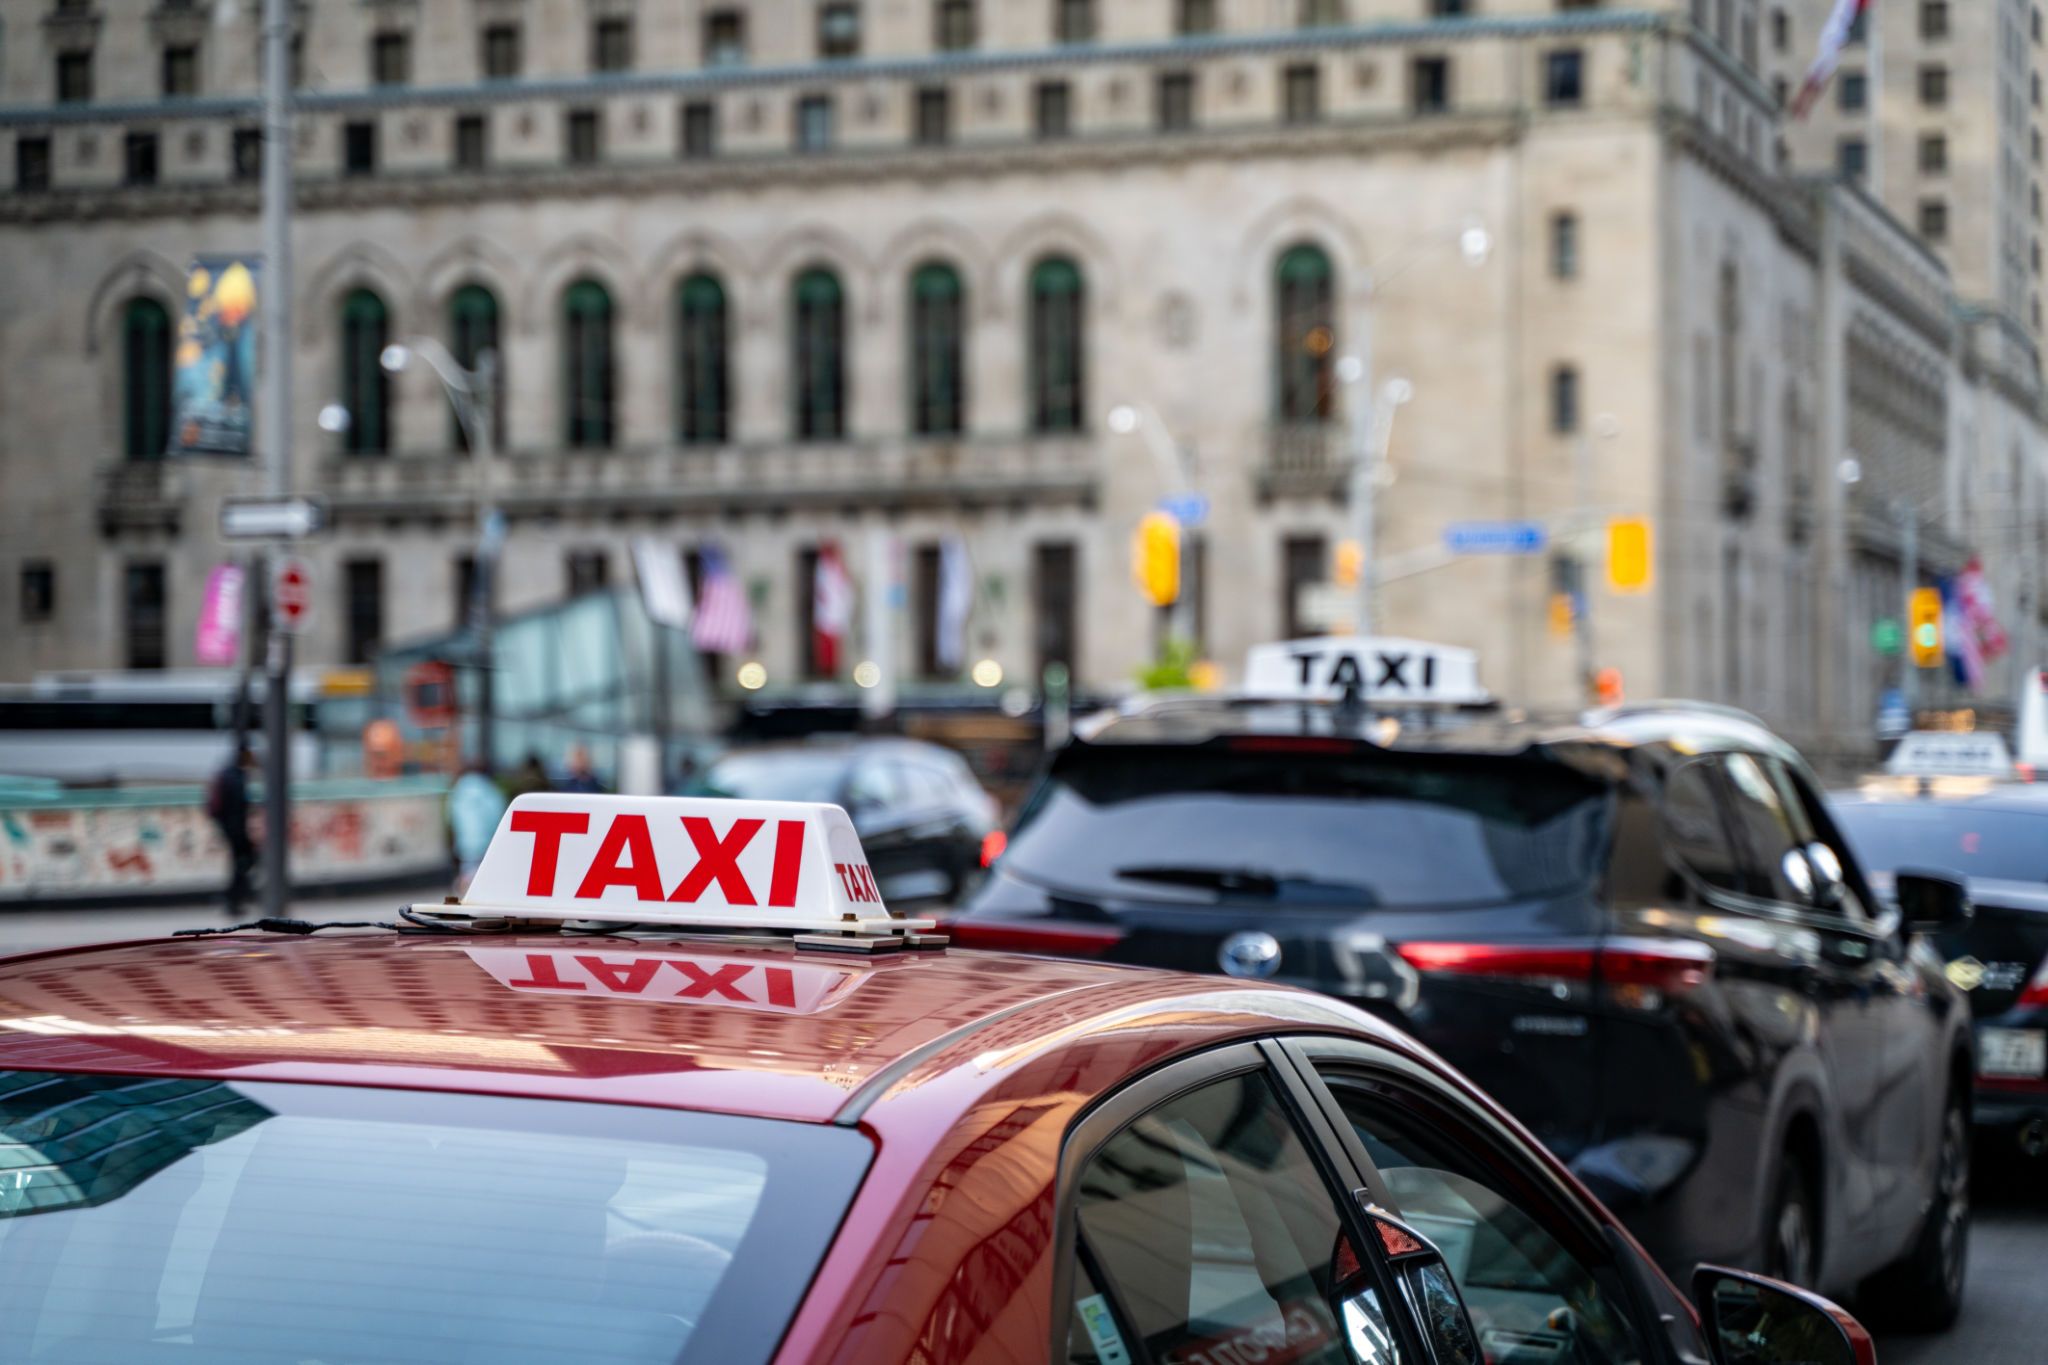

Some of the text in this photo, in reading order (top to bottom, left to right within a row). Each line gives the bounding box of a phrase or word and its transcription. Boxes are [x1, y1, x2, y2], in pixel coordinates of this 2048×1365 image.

[1290, 651, 1437, 690] TAXI
[510, 810, 806, 908] TAXI
[834, 863, 880, 903] TAXI
